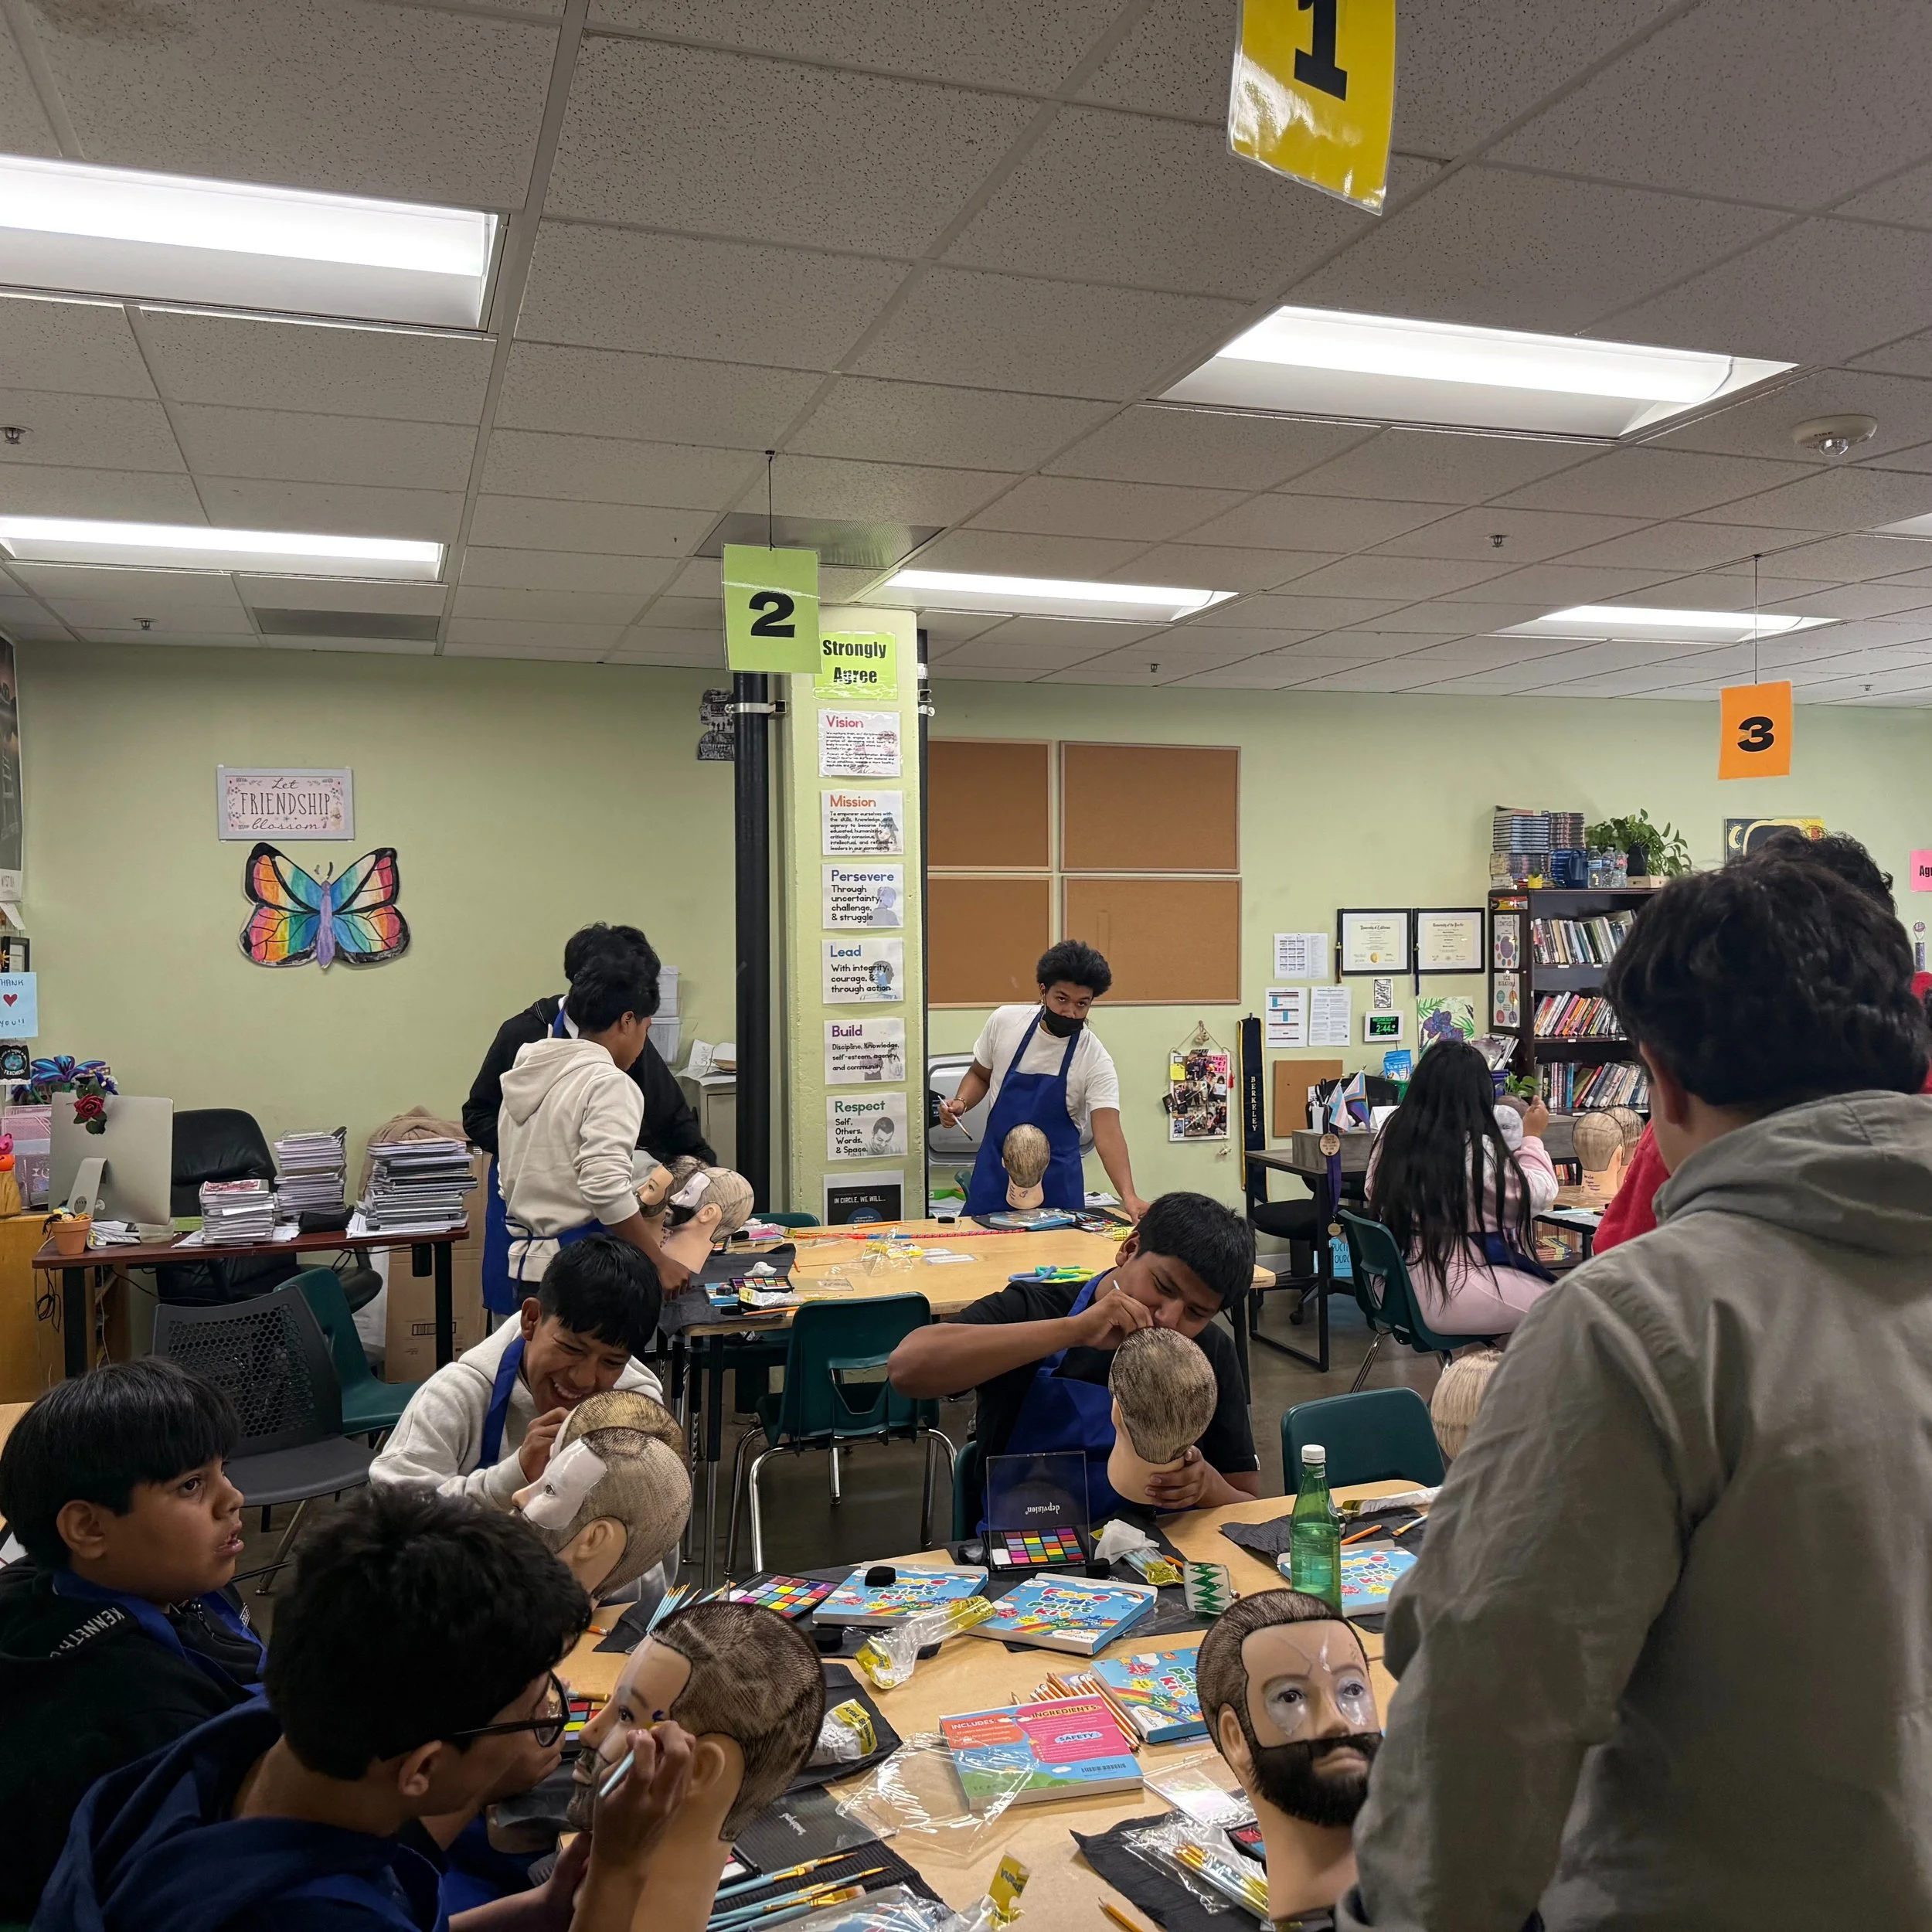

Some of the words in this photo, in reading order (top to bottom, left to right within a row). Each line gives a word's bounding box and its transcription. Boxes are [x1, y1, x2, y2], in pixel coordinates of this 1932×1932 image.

[1294, 0, 1347, 101] 1
[749, 590, 795, 638] 2
[822, 639, 886, 658] Strongly
[833, 667, 878, 685] Agree
[826, 715, 864, 728] Vision
[1737, 716, 1774, 752] 3
[271, 777, 300, 790] Let
[240, 792, 331, 815] FRIENDSHIP
[830, 794, 876, 807] Mission
[252, 818, 320, 830] blossom
[832, 869, 894, 882] Persevere
[832, 885, 867, 895] Through
[839, 913, 873, 923] struggle
[830, 944, 862, 957] Lead
[831, 964, 850, 972] With
[832, 985, 865, 994] through
[832, 1025, 862, 1037] Build
[835, 1100, 886, 1116] Respect
[1026, 1502, 1060, 1515] depvision
[1043, 1588, 1111, 1601] Face
[1027, 1601, 1094, 1613] Paint
[1034, 1608, 1073, 1618] Kit
[60, 1607, 125, 1648] KENNETH
[1160, 1676, 1188, 1697] Kit
